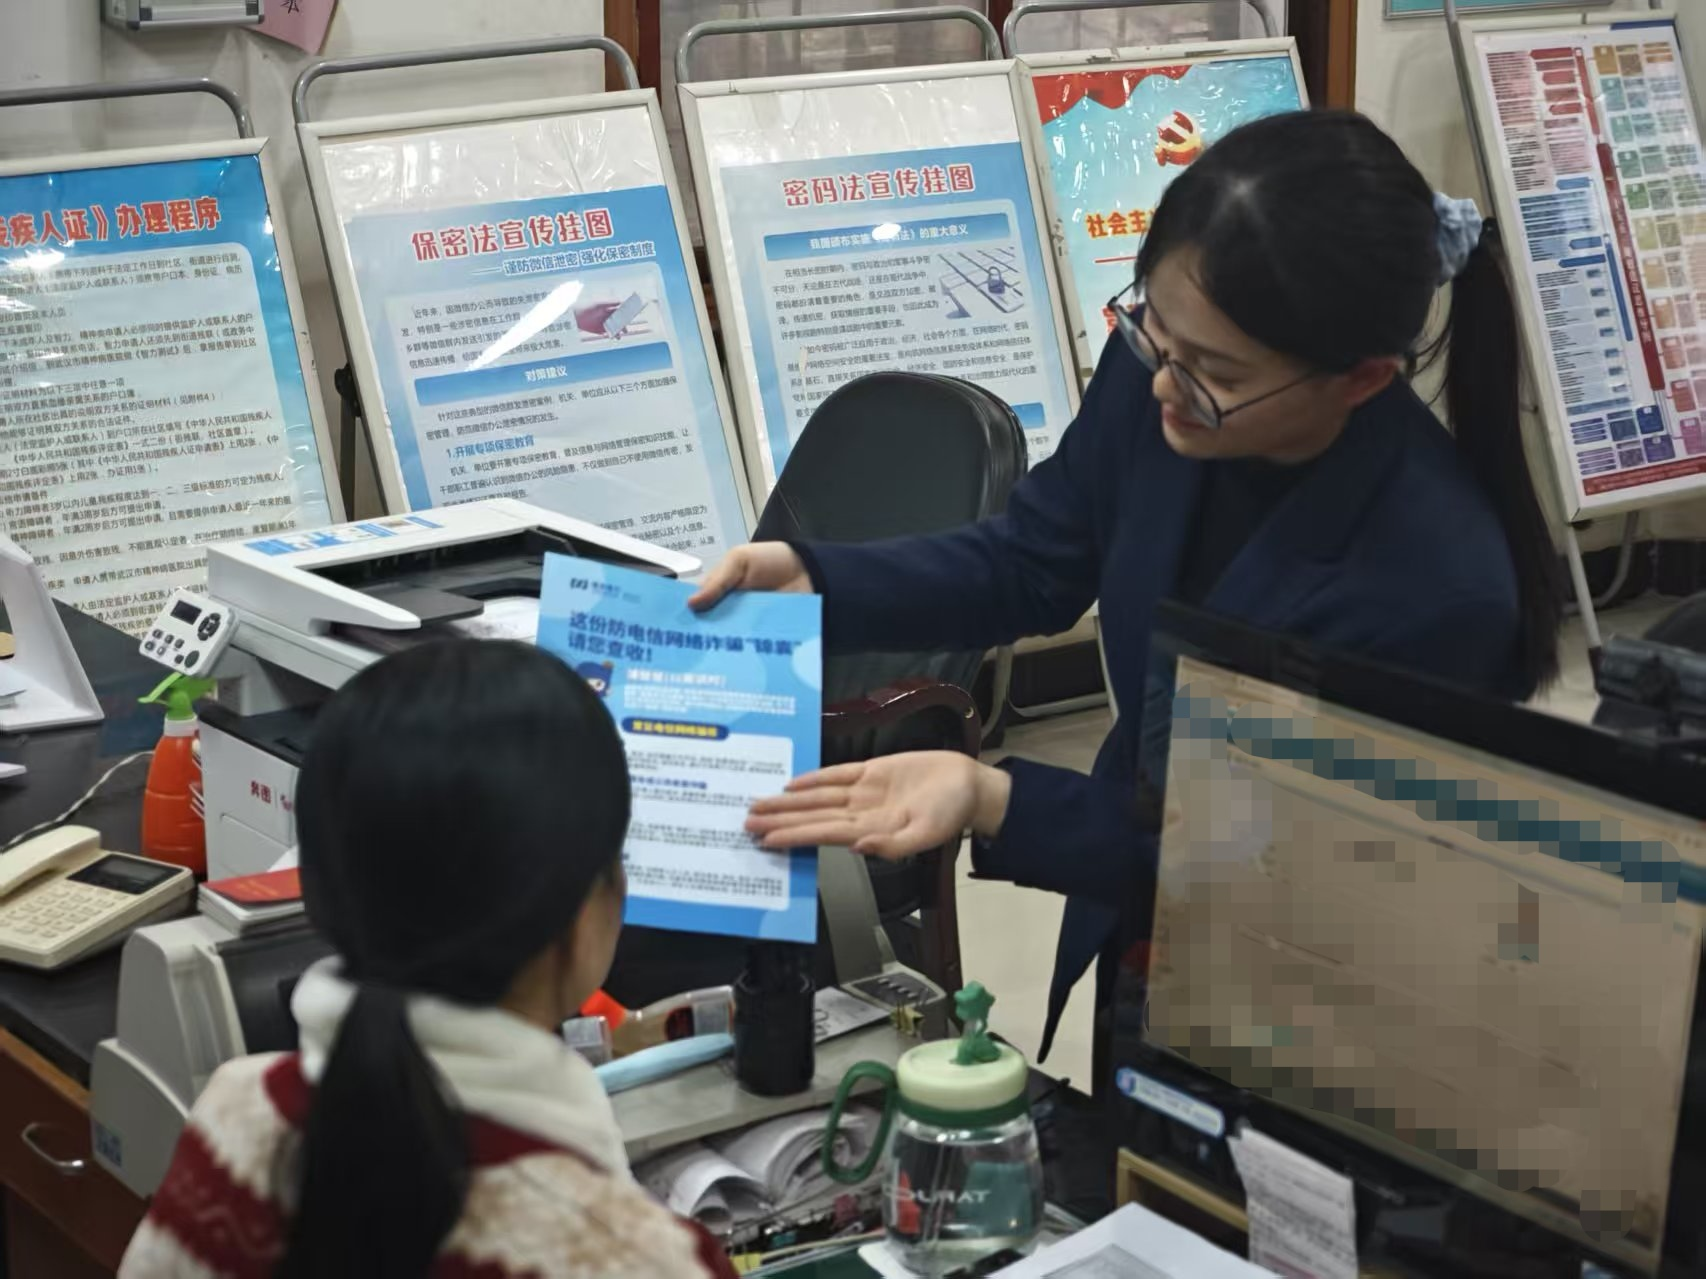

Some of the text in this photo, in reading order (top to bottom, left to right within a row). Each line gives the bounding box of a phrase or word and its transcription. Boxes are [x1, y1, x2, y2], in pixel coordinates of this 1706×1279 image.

[782, 163, 975, 208] 密码法宣传挂图
[411, 208, 613, 261] 保密法宣传挂图
[1086, 210, 1153, 238] 社会主
